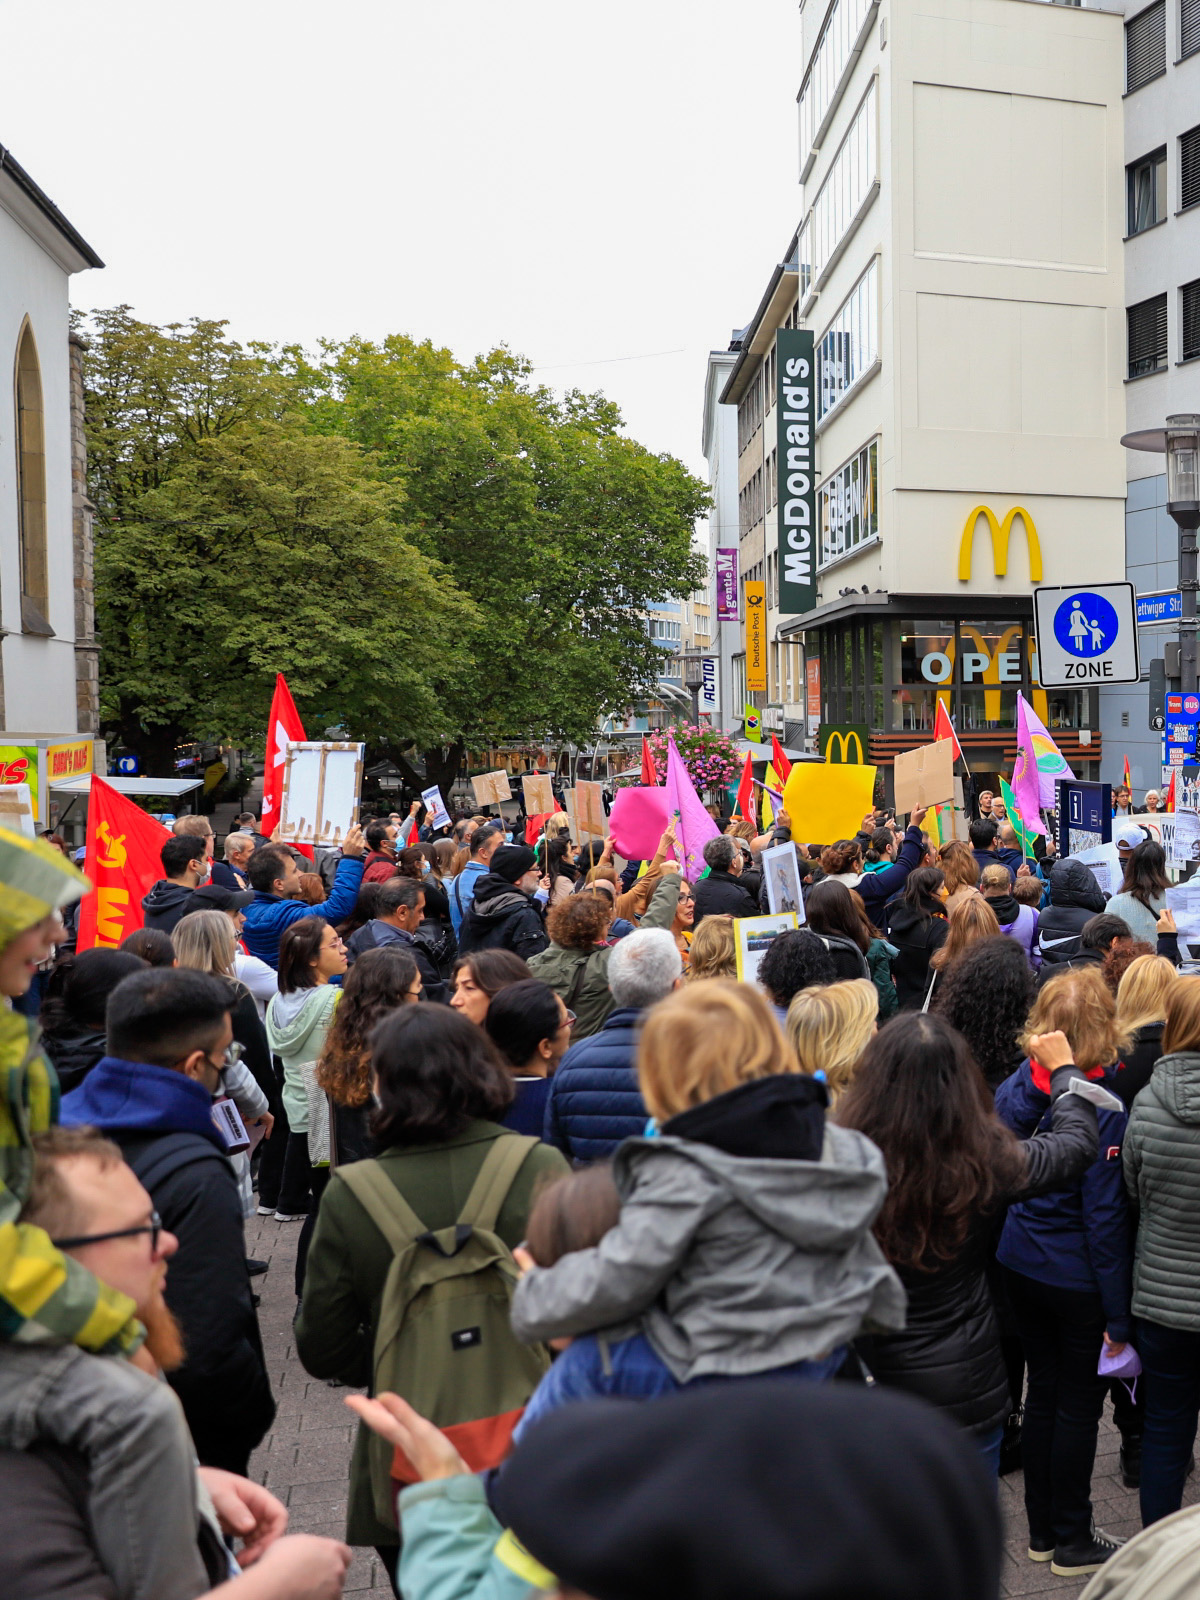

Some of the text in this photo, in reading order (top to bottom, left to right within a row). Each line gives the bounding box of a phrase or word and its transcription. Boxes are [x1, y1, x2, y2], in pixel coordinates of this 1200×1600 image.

[783, 357, 811, 586] McDonald's
[1137, 597, 1182, 618] ettwiger Str.
[752, 612, 760, 668] Deutsche Post
[921, 651, 1038, 683] OPE
[1064, 661, 1114, 679] ZONE
[1185, 701, 1198, 709] BUS
